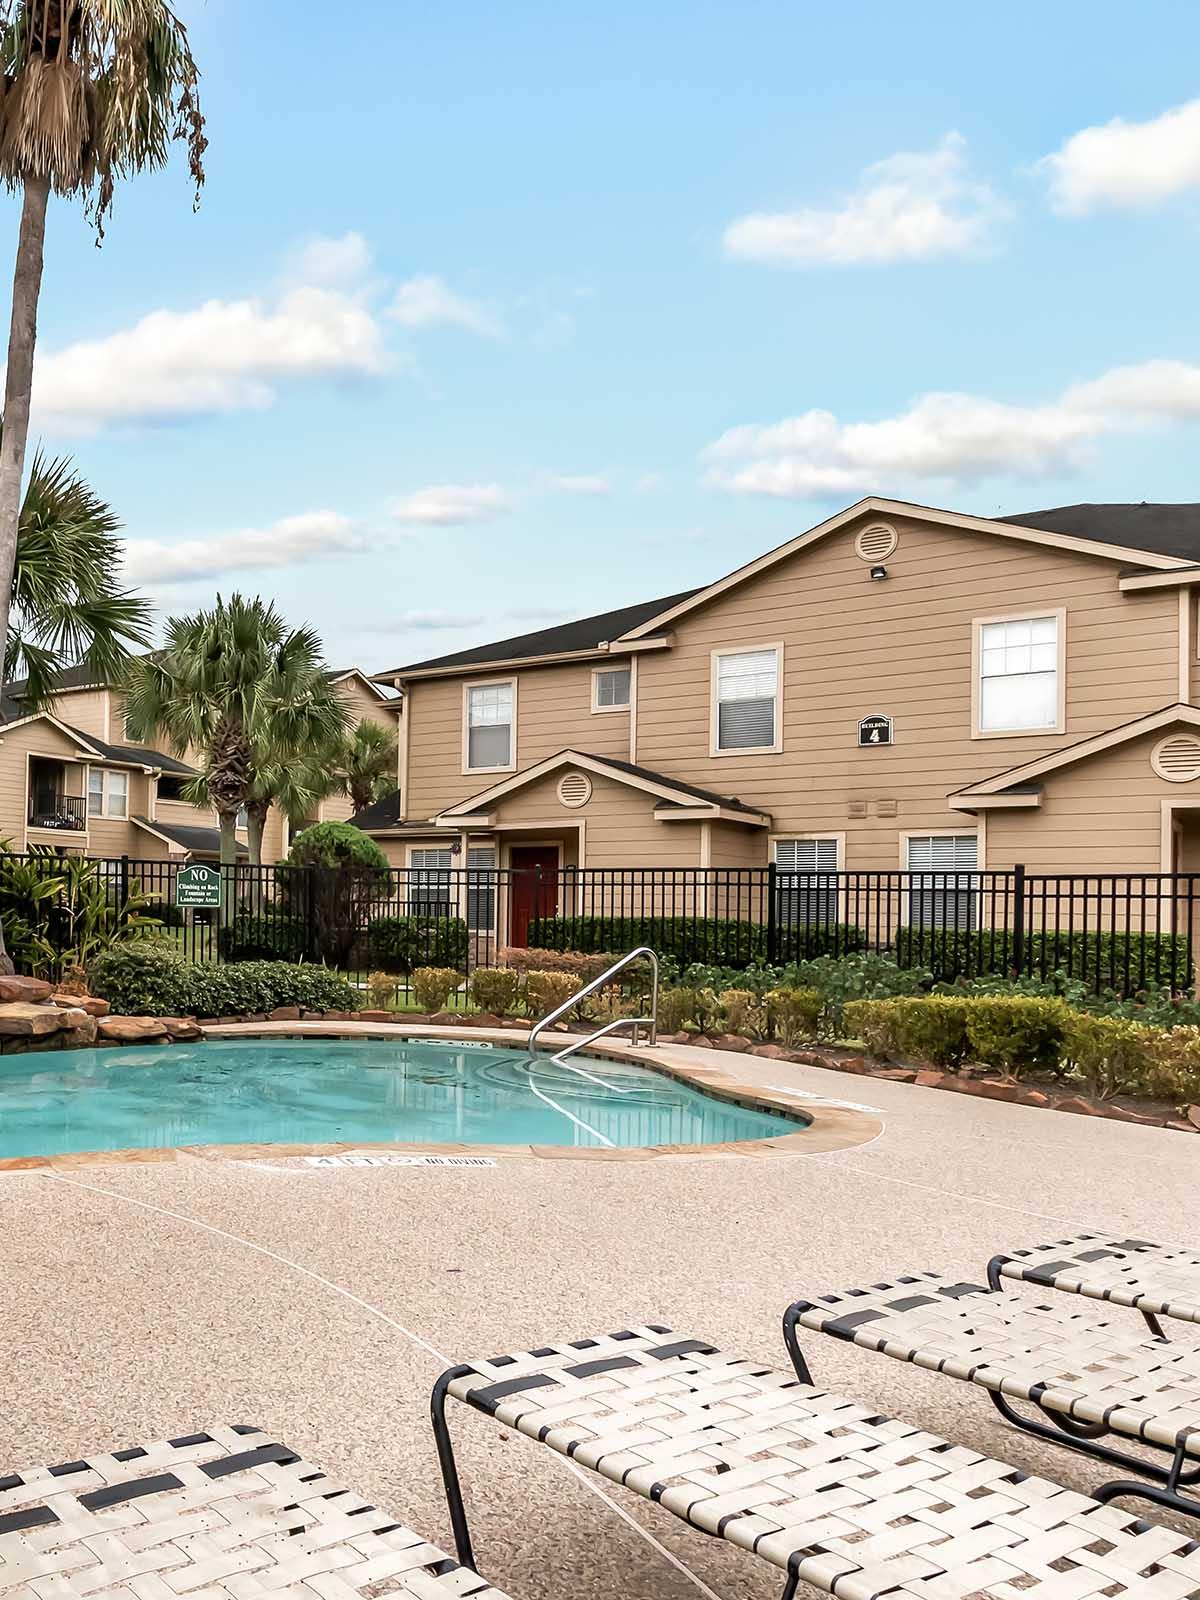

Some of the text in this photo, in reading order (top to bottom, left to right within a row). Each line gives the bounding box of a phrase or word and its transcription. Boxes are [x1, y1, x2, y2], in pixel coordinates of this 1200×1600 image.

[870, 729, 880, 742] 4
[191, 869, 208, 881] NO
[447, 1158, 493, 1166] DIVING
